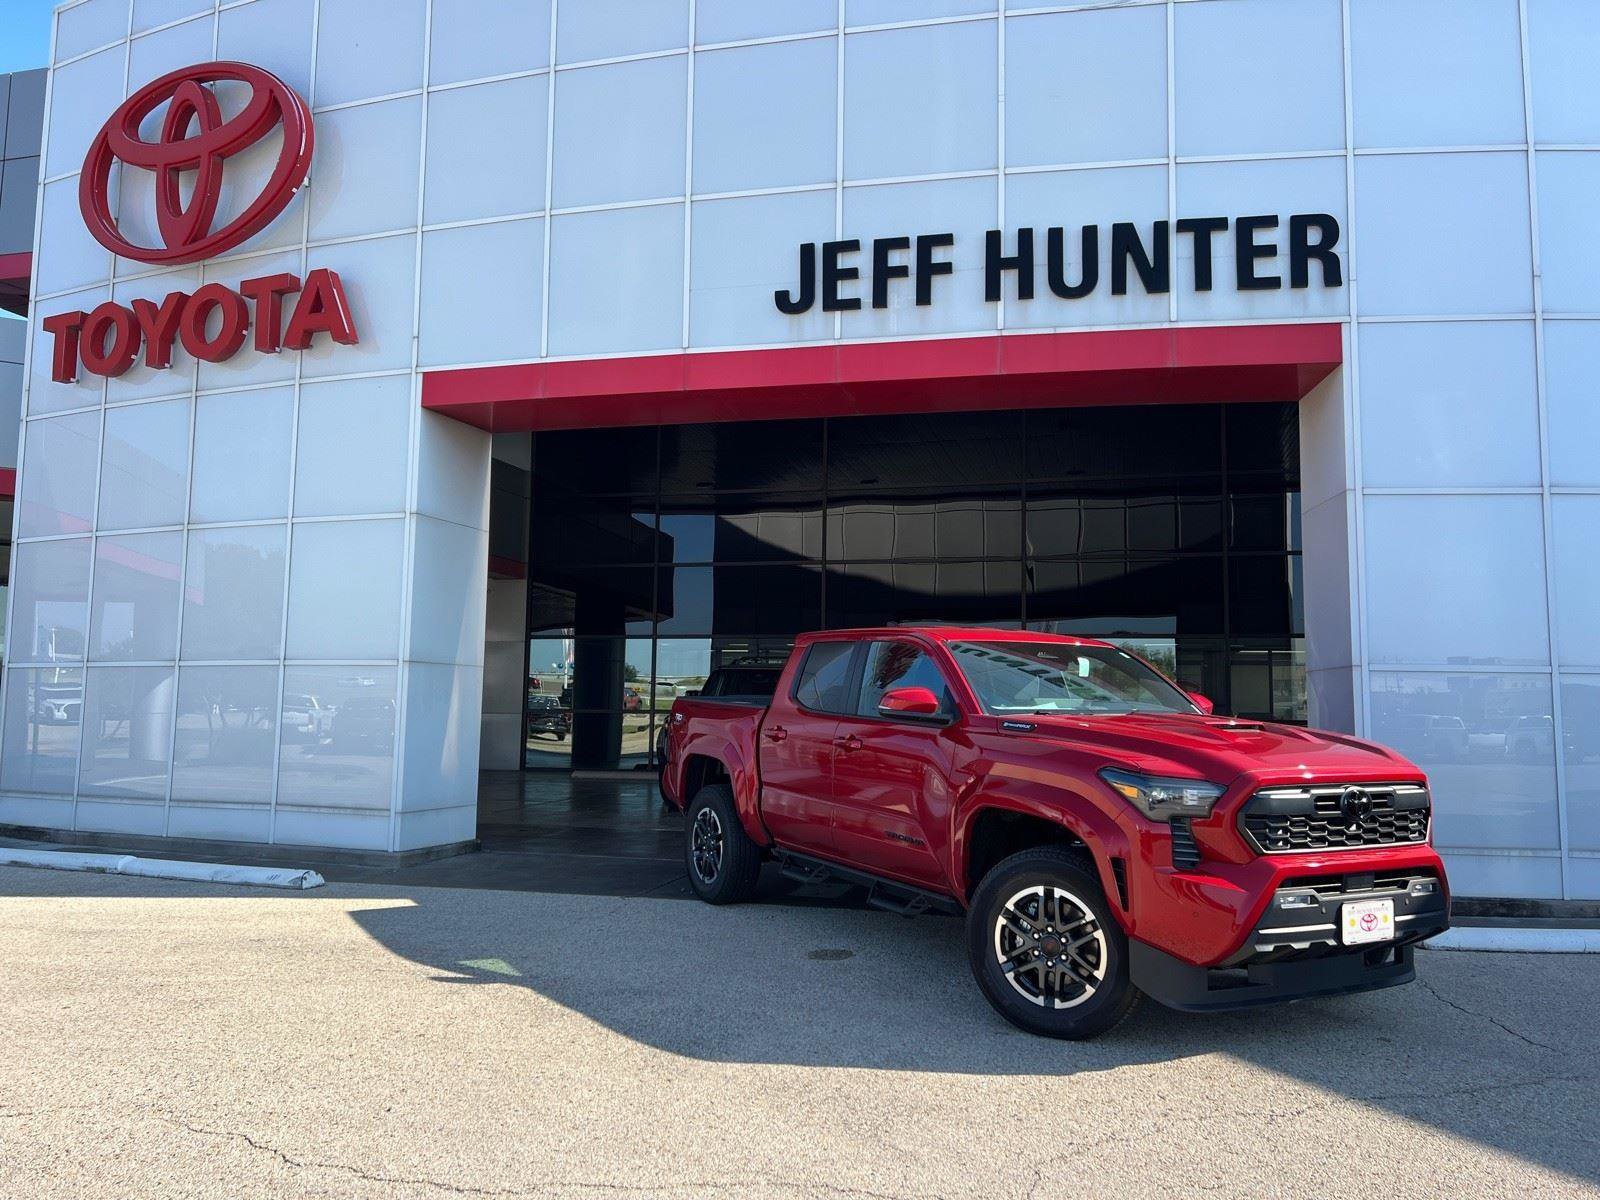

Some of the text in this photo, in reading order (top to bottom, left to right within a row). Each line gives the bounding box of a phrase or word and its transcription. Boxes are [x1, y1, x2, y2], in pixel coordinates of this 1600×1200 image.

[775, 214, 1342, 314] JEFF HUNTER
[43, 268, 359, 384] TOYOTA
